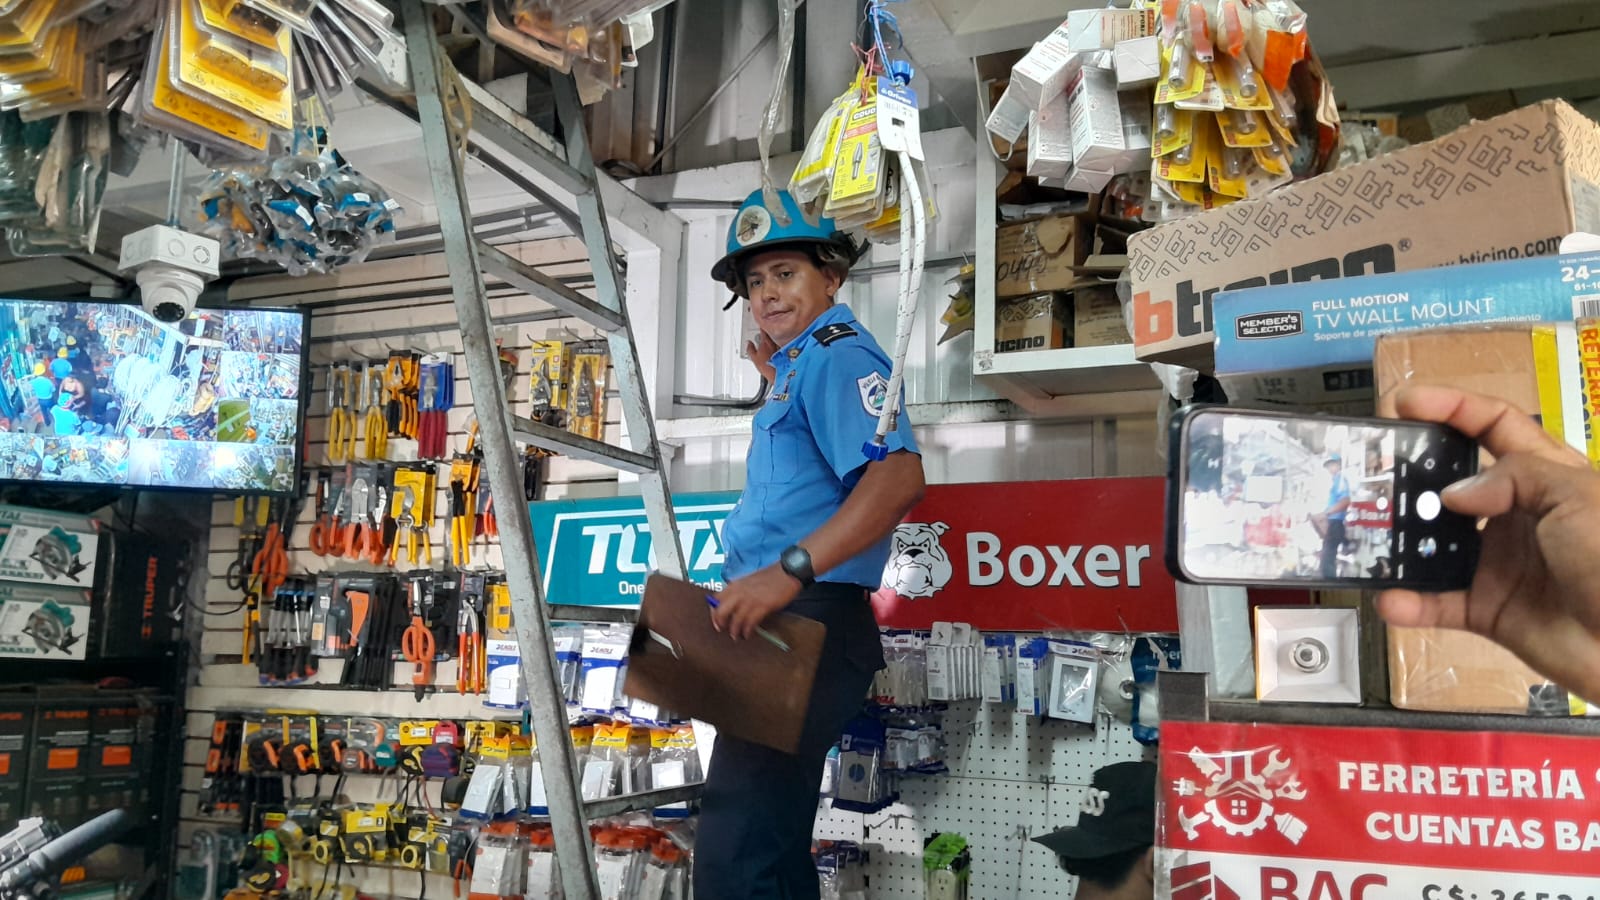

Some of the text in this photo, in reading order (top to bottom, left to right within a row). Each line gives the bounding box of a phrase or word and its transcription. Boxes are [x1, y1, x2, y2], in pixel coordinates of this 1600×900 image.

[1312, 292, 1410, 312] FULL MOTION
[1313, 312, 1342, 330] TV
[1346, 307, 1405, 328] WALL
[1411, 297, 1494, 321] MOUNT
[1239, 314, 1298, 330] MEMBER'S
[1242, 323, 1297, 335] SELECTION
[1313, 329, 1352, 343] Soporte
[1352, 328, 1366, 338] de
[581, 518, 726, 575] TOTA
[966, 531, 1151, 588] Boxer
[1338, 759, 1586, 801] FERRETERÍA
[1366, 811, 1545, 850] CUENTAS
[1259, 866, 1390, 900] BAC
